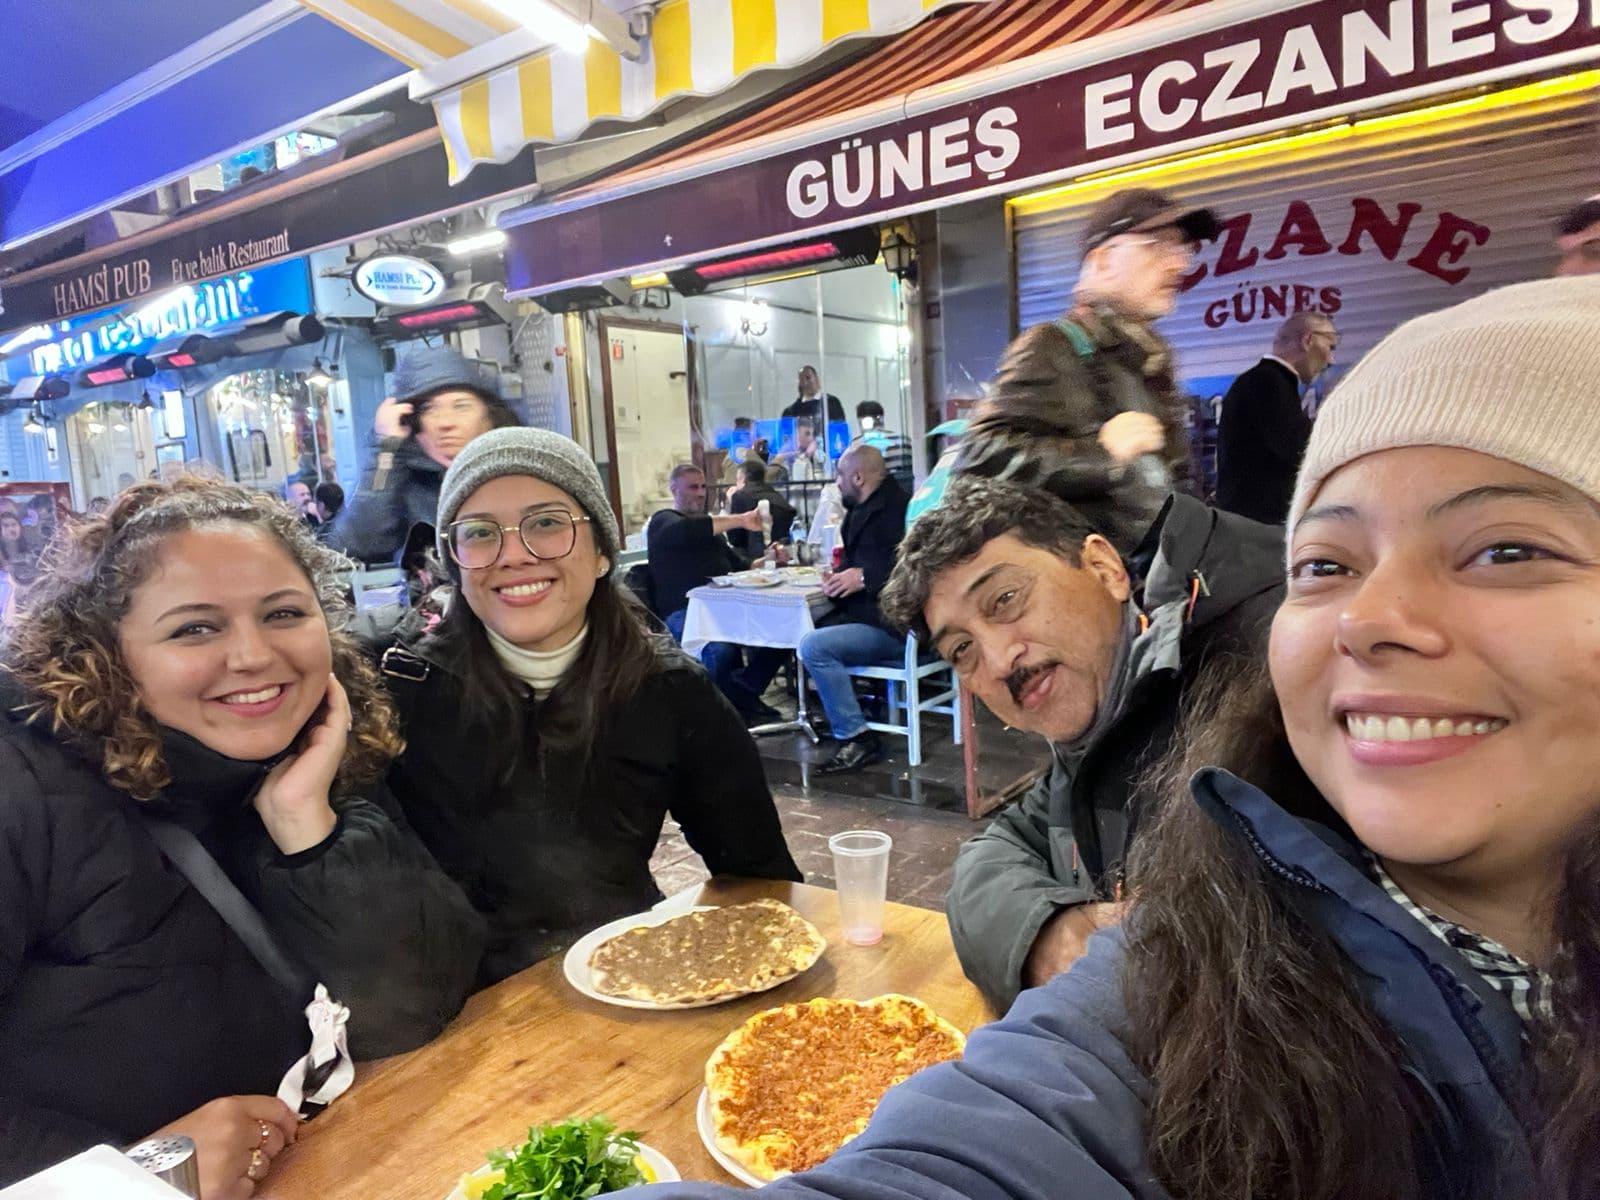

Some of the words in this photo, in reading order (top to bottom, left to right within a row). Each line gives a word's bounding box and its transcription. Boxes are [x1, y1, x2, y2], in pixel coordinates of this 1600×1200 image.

[786, 106, 1021, 218] GÜNEŞ
[54, 263, 109, 316] HAMSİ
[113, 259, 151, 300] PUB
[185, 260, 198, 280] ve
[228, 227, 290, 269] Restaurant
[1176, 198, 1491, 293] ZANE
